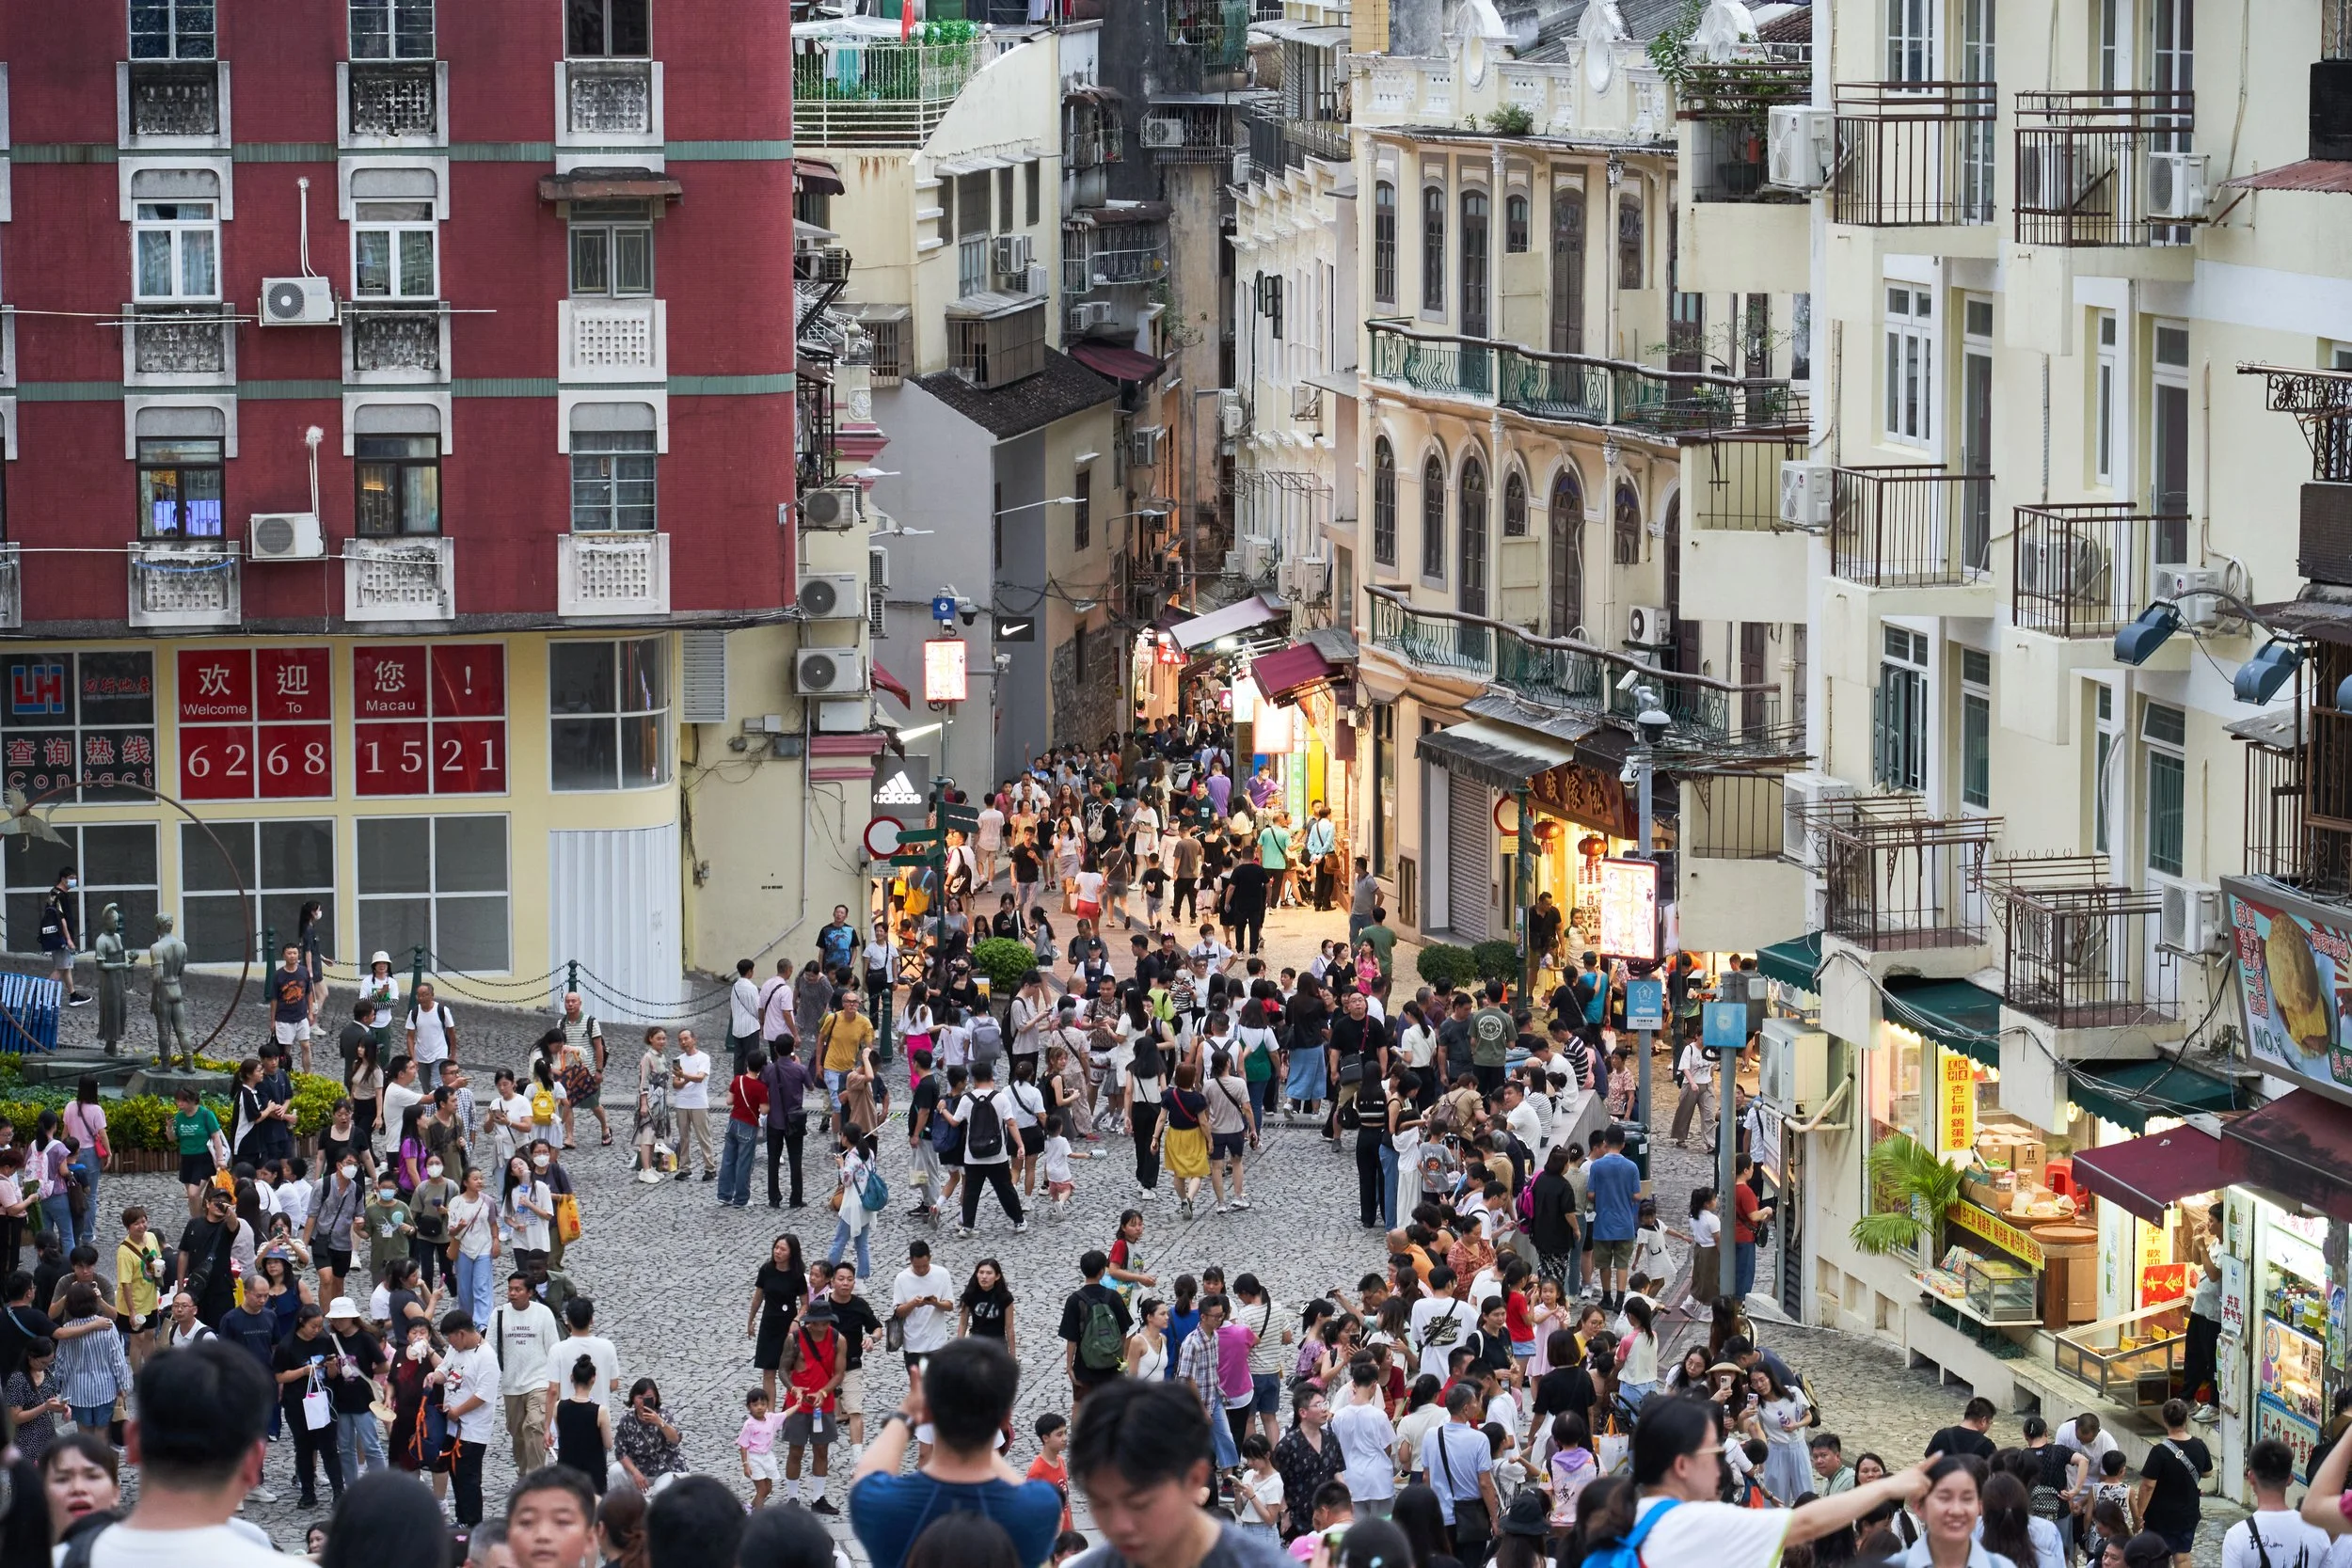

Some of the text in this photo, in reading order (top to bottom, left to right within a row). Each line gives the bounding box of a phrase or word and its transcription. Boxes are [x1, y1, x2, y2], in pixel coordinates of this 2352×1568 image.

[183, 699, 416, 716] Welcome To Macau
[7, 736, 152, 767] 查询热线
[188, 739, 500, 777] 6268 1521
[8, 768, 152, 789] Contact
[873, 791, 922, 804] adidas
